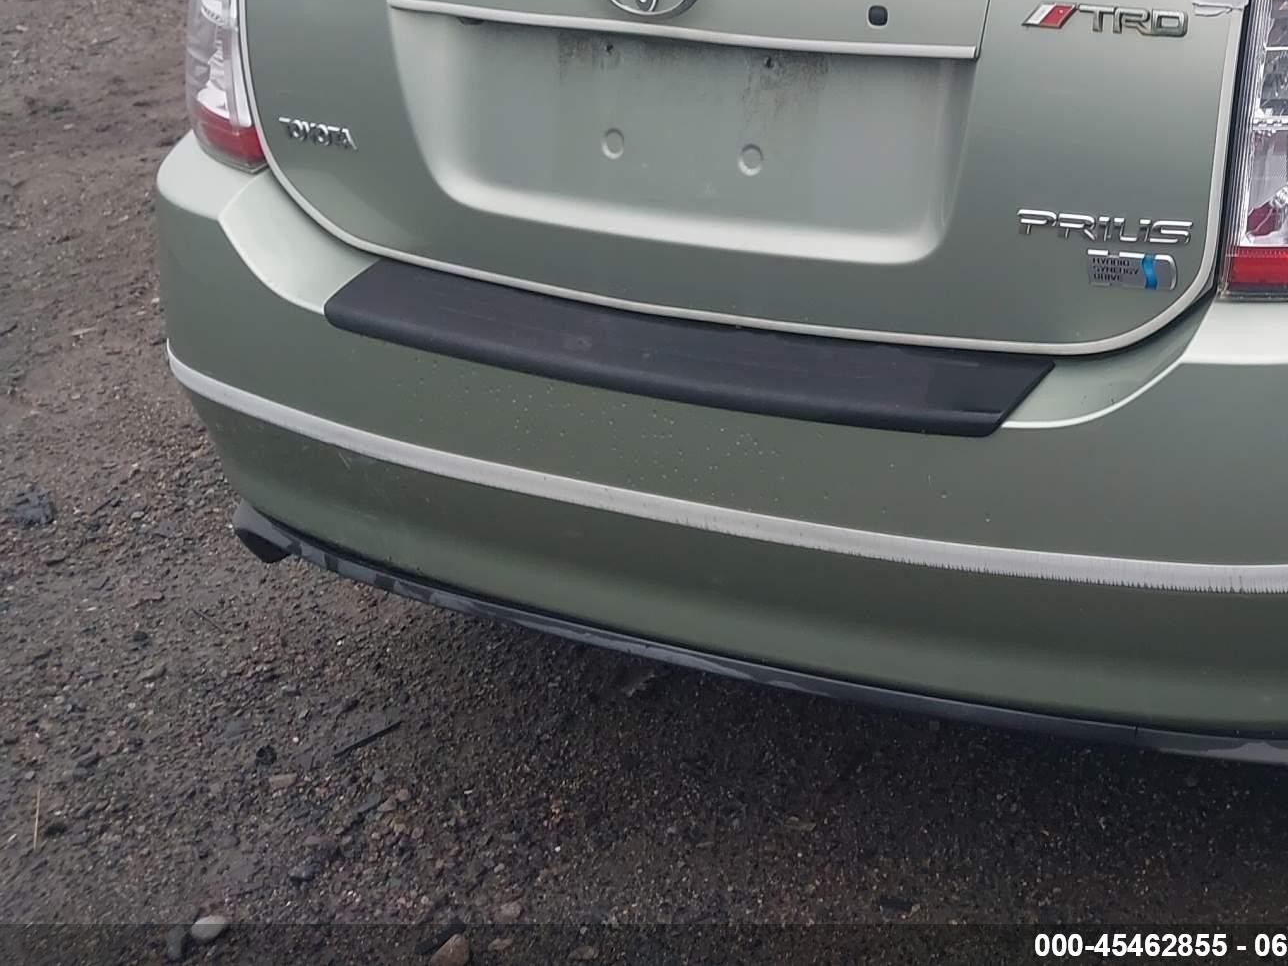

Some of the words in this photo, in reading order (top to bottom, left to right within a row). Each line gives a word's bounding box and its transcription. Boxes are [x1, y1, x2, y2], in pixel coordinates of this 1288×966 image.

[1077, 4, 1189, 38] TRD
[278, 116, 358, 150] TOYOTA
[1017, 208, 1195, 244] PRIUS
